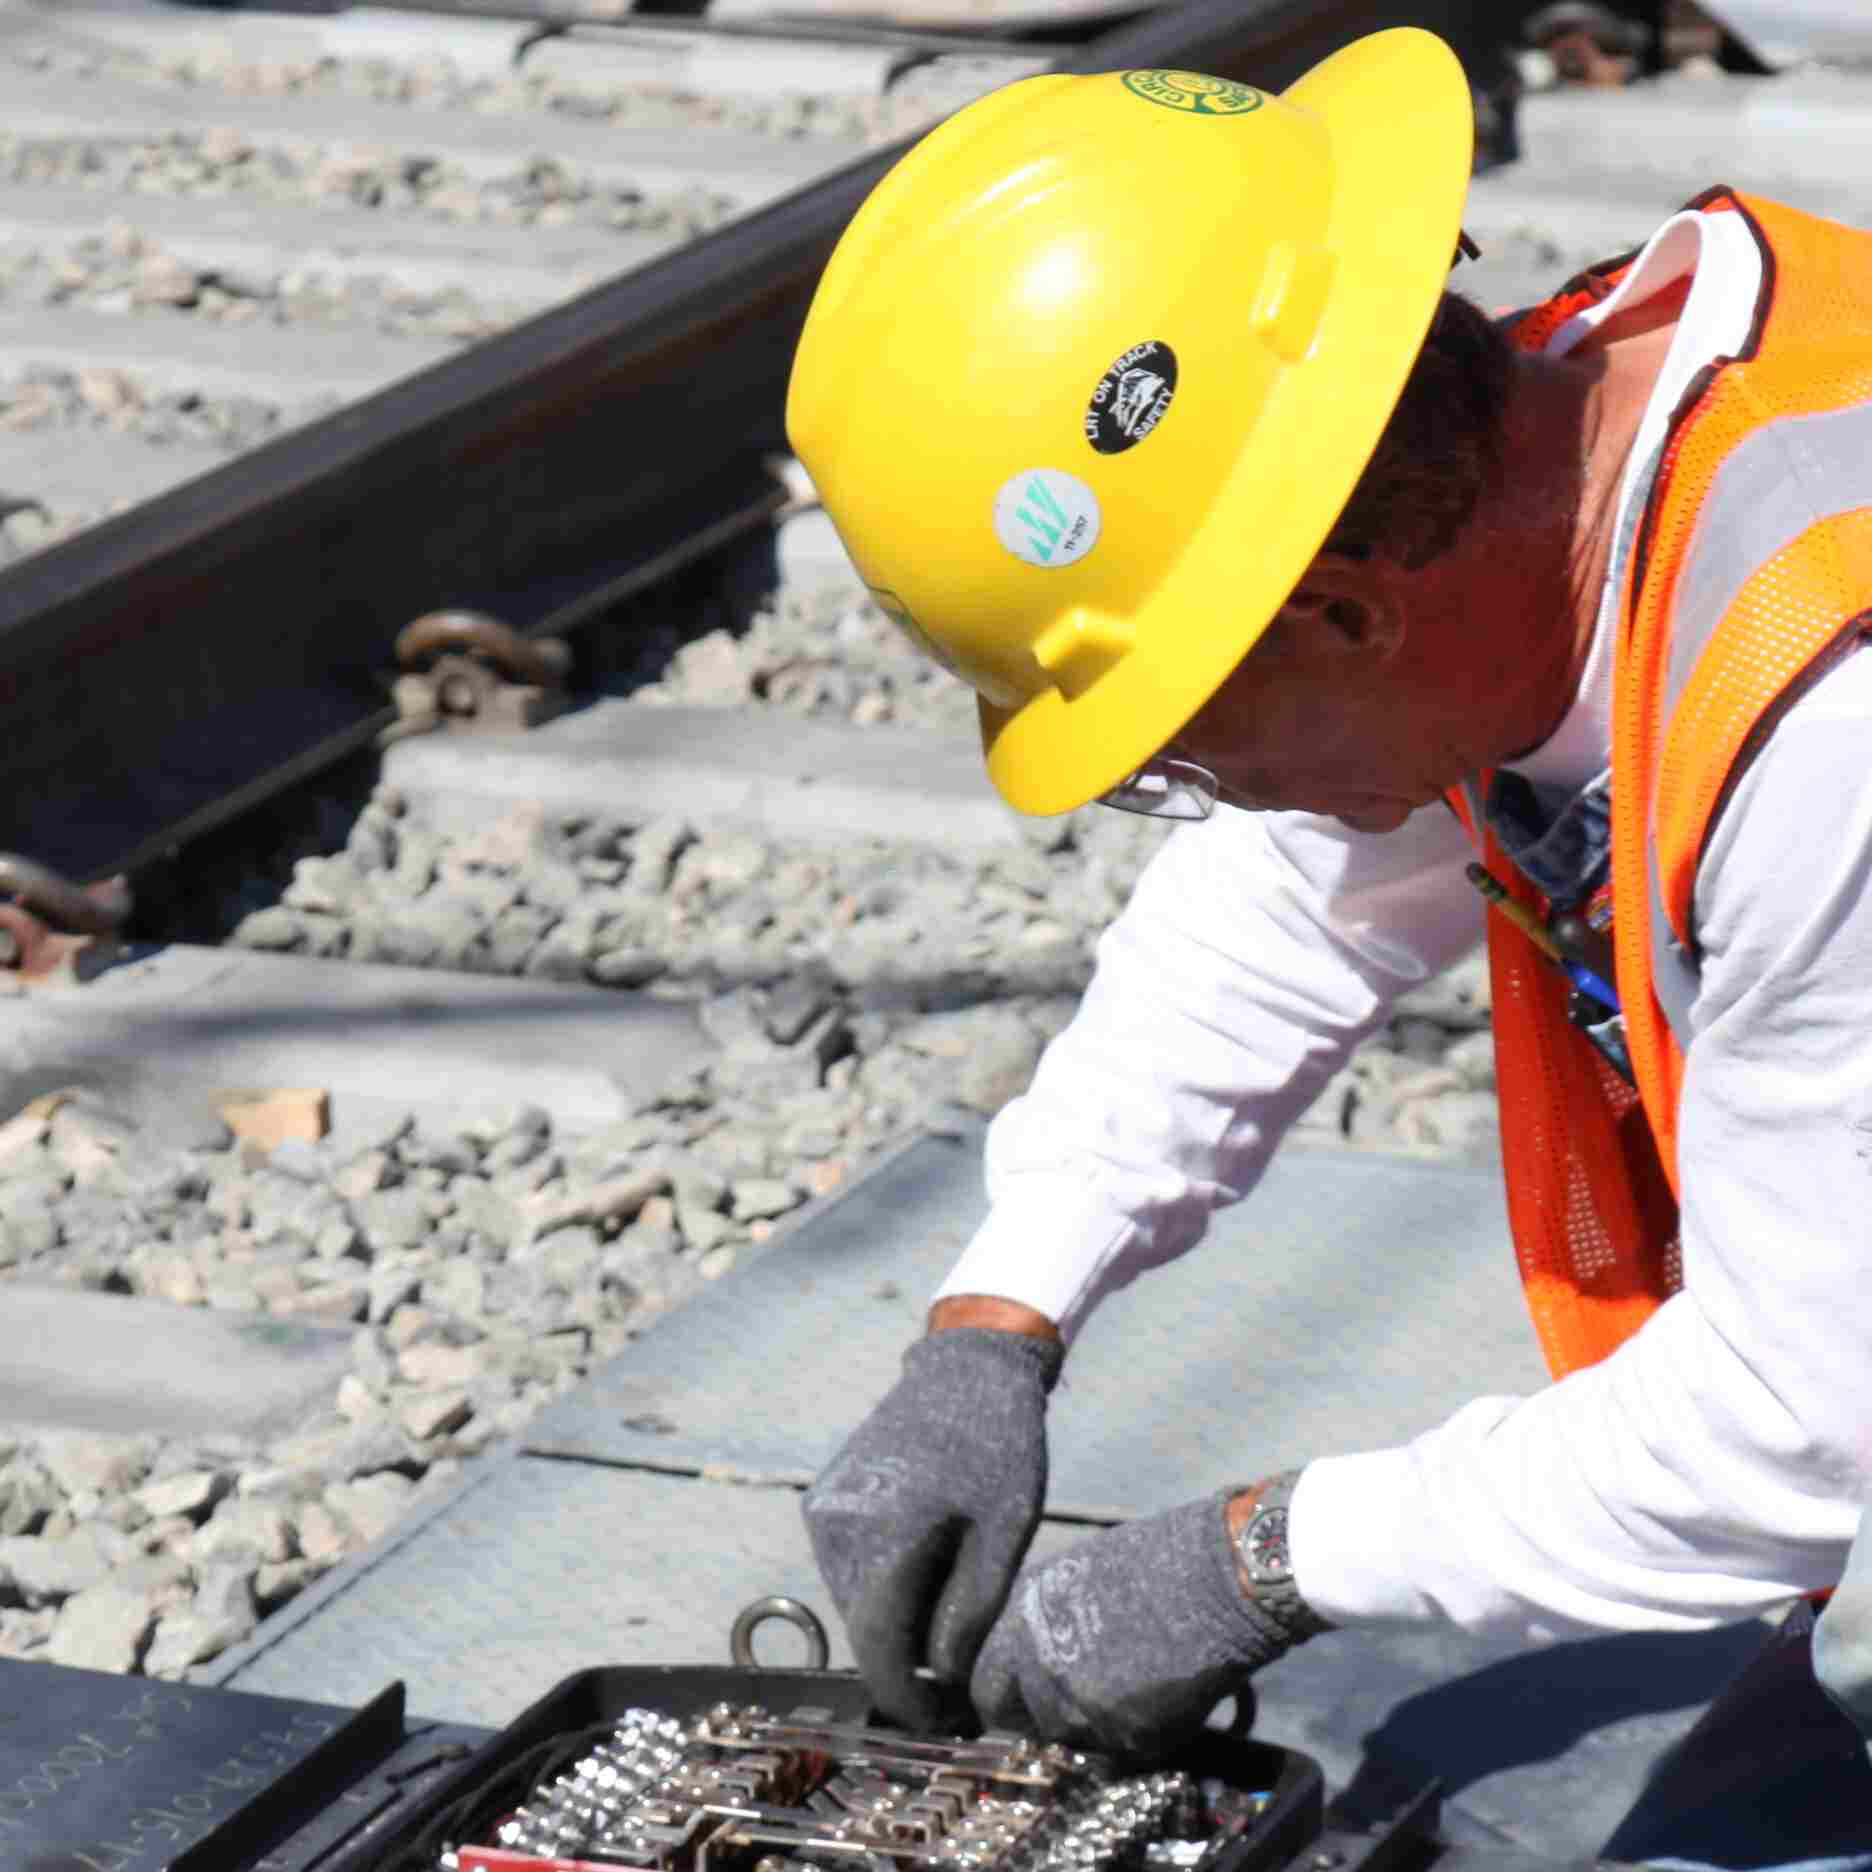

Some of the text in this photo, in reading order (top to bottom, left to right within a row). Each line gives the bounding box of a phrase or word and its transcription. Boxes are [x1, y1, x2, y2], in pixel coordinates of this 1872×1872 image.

[1093, 378, 1113, 404] ON
[1109, 341, 1159, 378] TRACK
[1133, 386, 1175, 440] SAFETY
